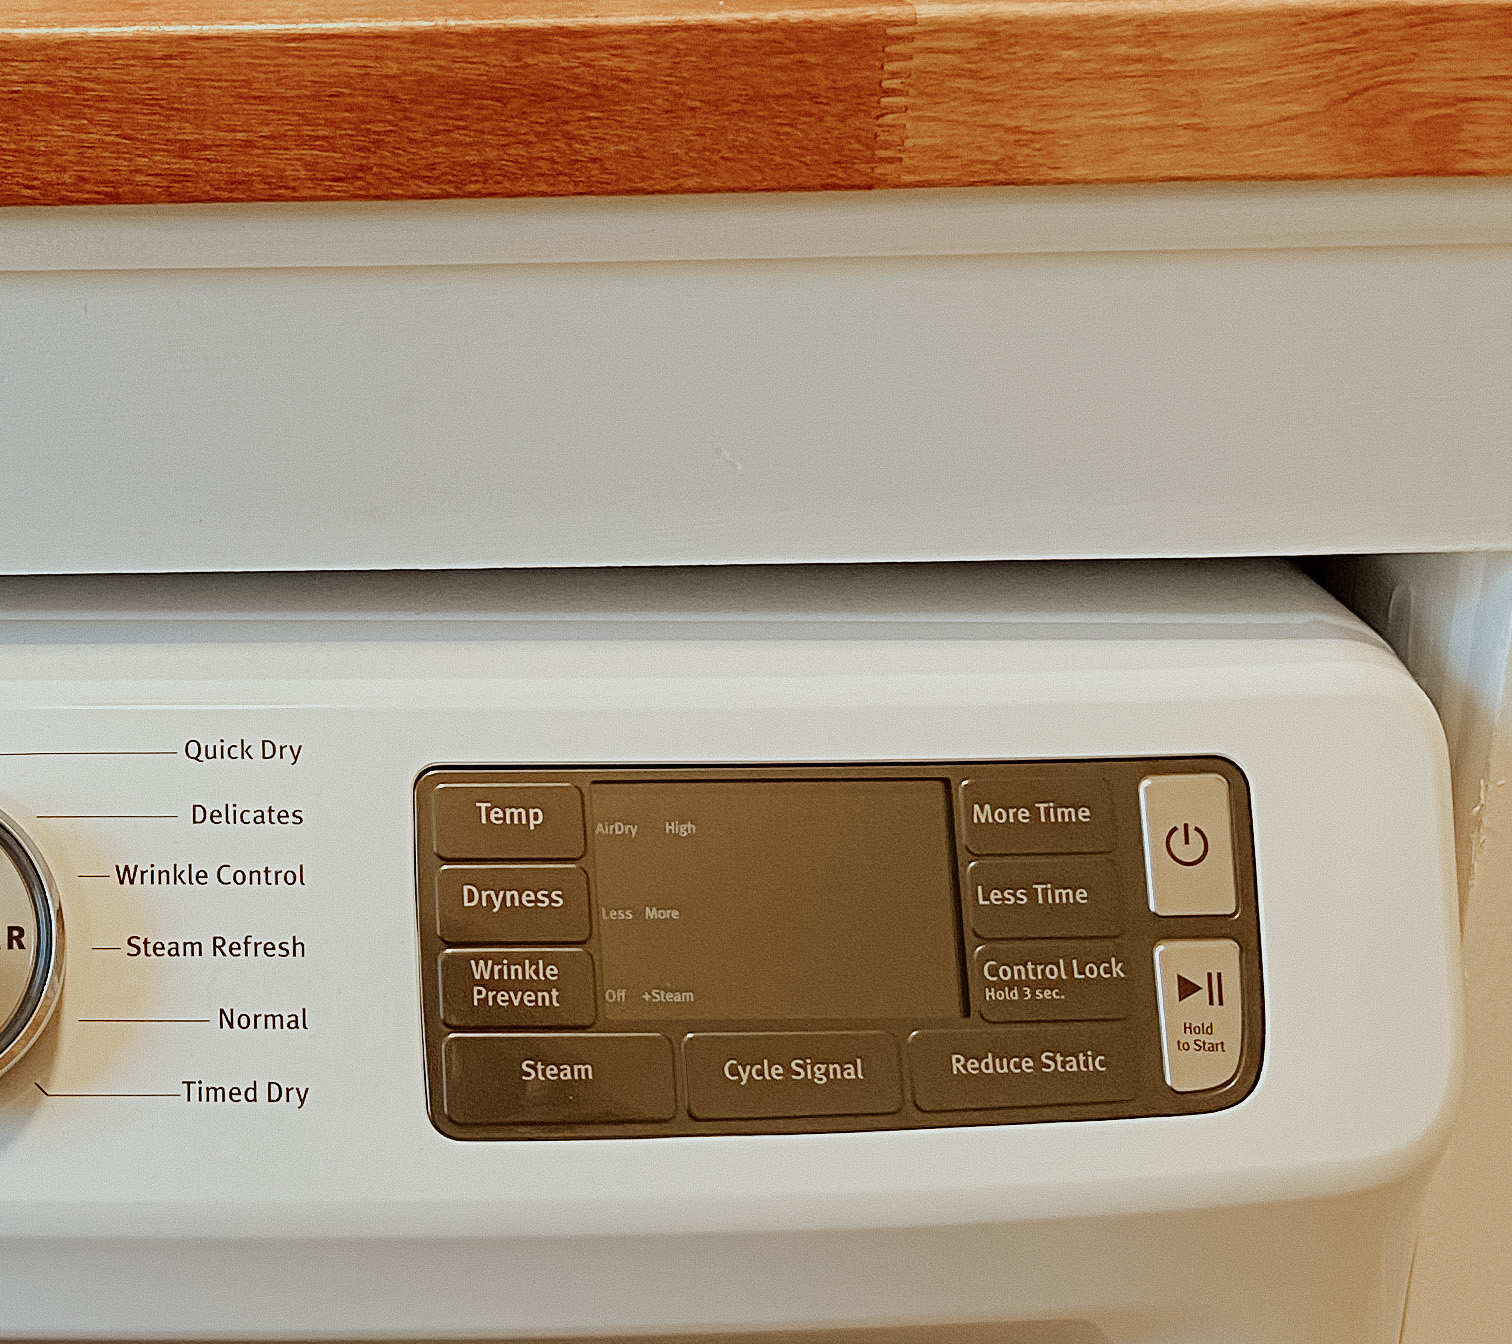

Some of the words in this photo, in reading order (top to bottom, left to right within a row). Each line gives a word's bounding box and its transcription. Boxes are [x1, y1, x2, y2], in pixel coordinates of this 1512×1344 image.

[185, 739, 253, 762] Quick
[262, 740, 302, 765] Dry
[193, 804, 303, 825] Delicates
[476, 803, 543, 830] Temp
[974, 804, 1029, 823] More
[1035, 803, 1090, 822] Time
[596, 822, 637, 837] AirDry
[666, 821, 696, 836] High
[115, 864, 208, 885] Wrinkle
[217, 865, 305, 885] Control
[463, 885, 563, 912] Dryness
[978, 886, 1027, 904] Less
[1033, 884, 1087, 903] Time
[602, 908, 633, 919] Less
[646, 907, 679, 919] More
[127, 936, 202, 957] Steam
[213, 935, 305, 957] Refresh
[471, 960, 558, 980] Wrinkle
[984, 959, 1067, 981] Control
[1073, 958, 1125, 978] Lock
[474, 987, 559, 1006] Prevent
[606, 989, 626, 1002] Off
[643, 990, 694, 1002] +Steam
[986, 987, 1018, 1000] Hold
[1023, 987, 1031, 1000] 3
[1036, 989, 1065, 999] sec.
[220, 1008, 307, 1029] Normal
[1184, 1022, 1213, 1035] Hold
[1177, 1040, 1190, 1051] to
[1194, 1039, 1225, 1052] Start
[522, 1061, 592, 1080] Steam
[724, 1059, 784, 1085] Cycle
[791, 1058, 864, 1084] Signal
[952, 1053, 1033, 1074] Reduce
[1041, 1051, 1106, 1072] Static
[182, 1080, 257, 1102] Timed
[268, 1082, 309, 1109] Dry
